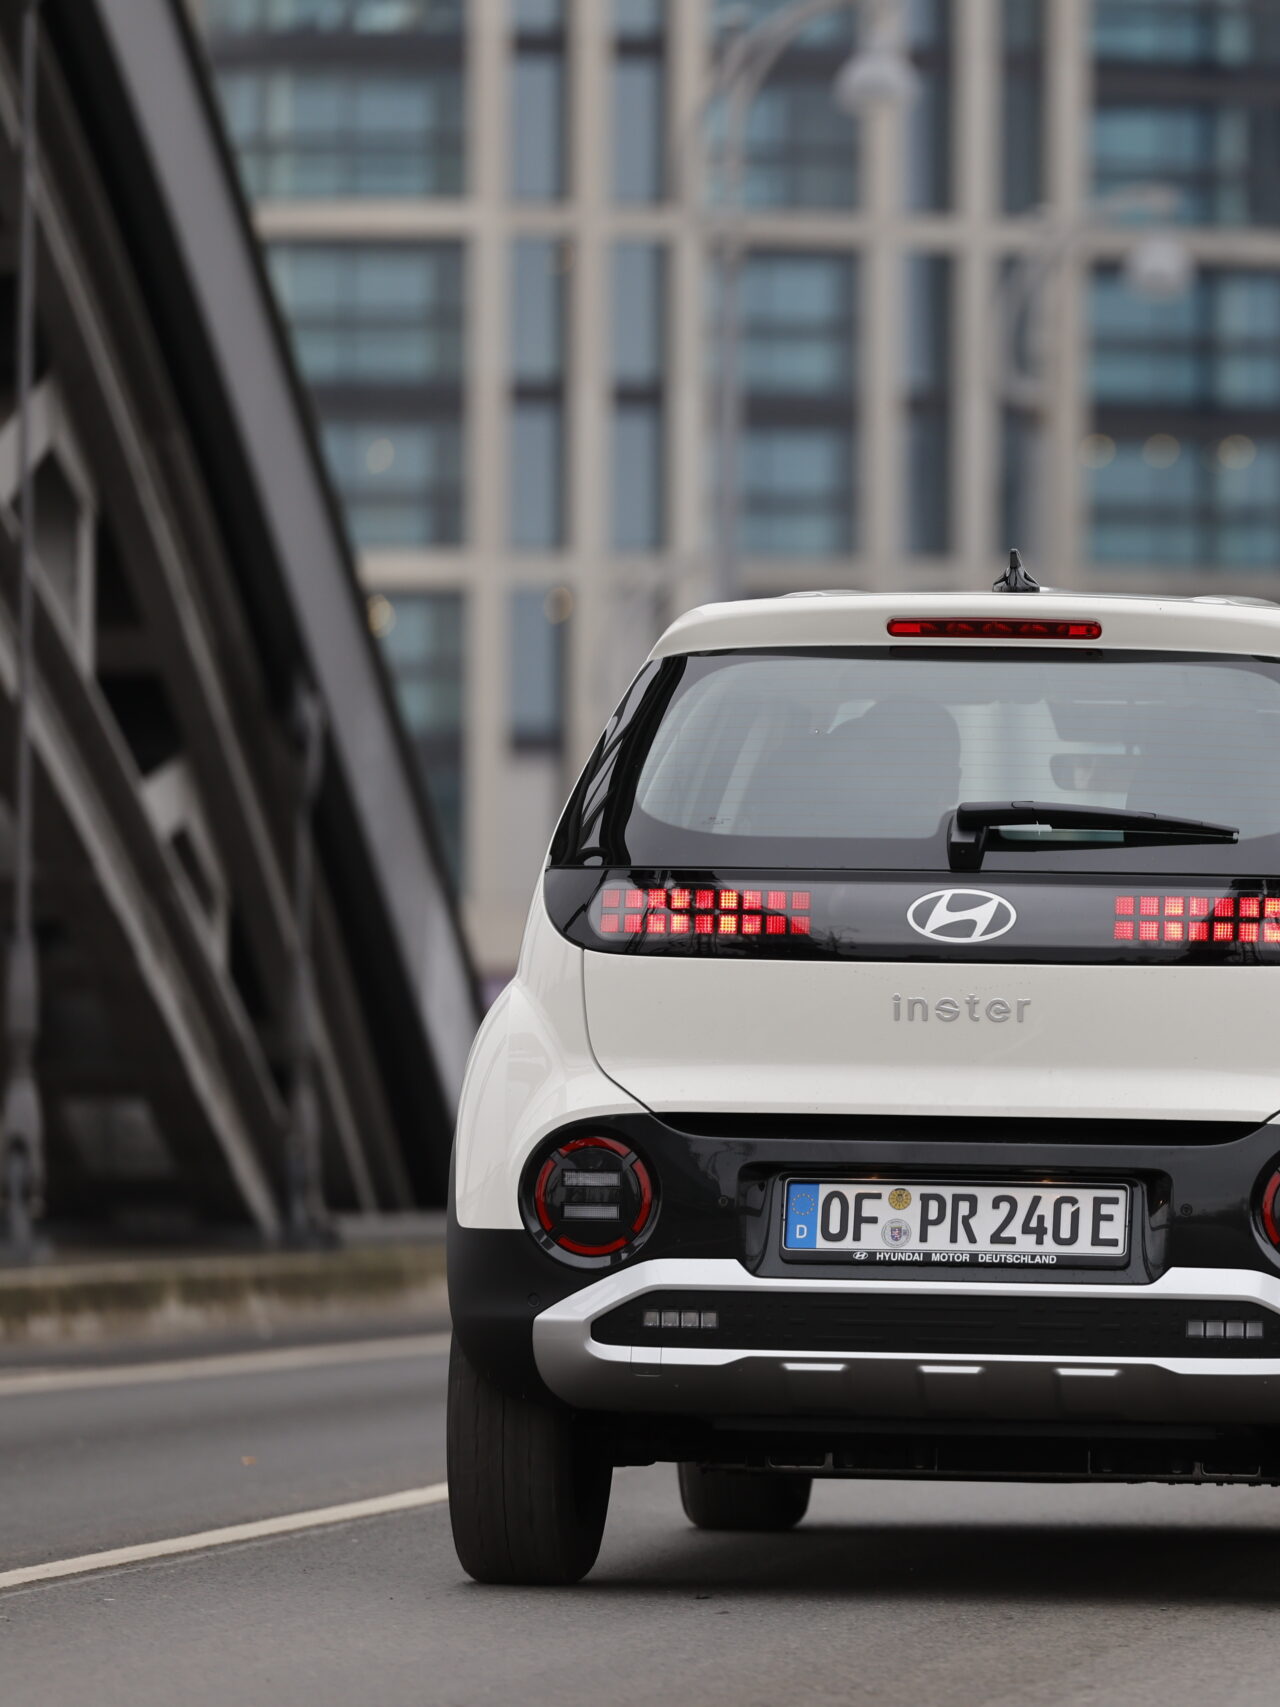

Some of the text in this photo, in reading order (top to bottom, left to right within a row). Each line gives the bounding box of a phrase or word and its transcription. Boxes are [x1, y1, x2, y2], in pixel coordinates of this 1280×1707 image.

[892, 992, 1031, 1024] inster
[820, 1190, 882, 1243] OF
[795, 1223, 808, 1240] D
[875, 1251, 1057, 1264] HYUNDAI MOTOR DEUTSCHLAND
